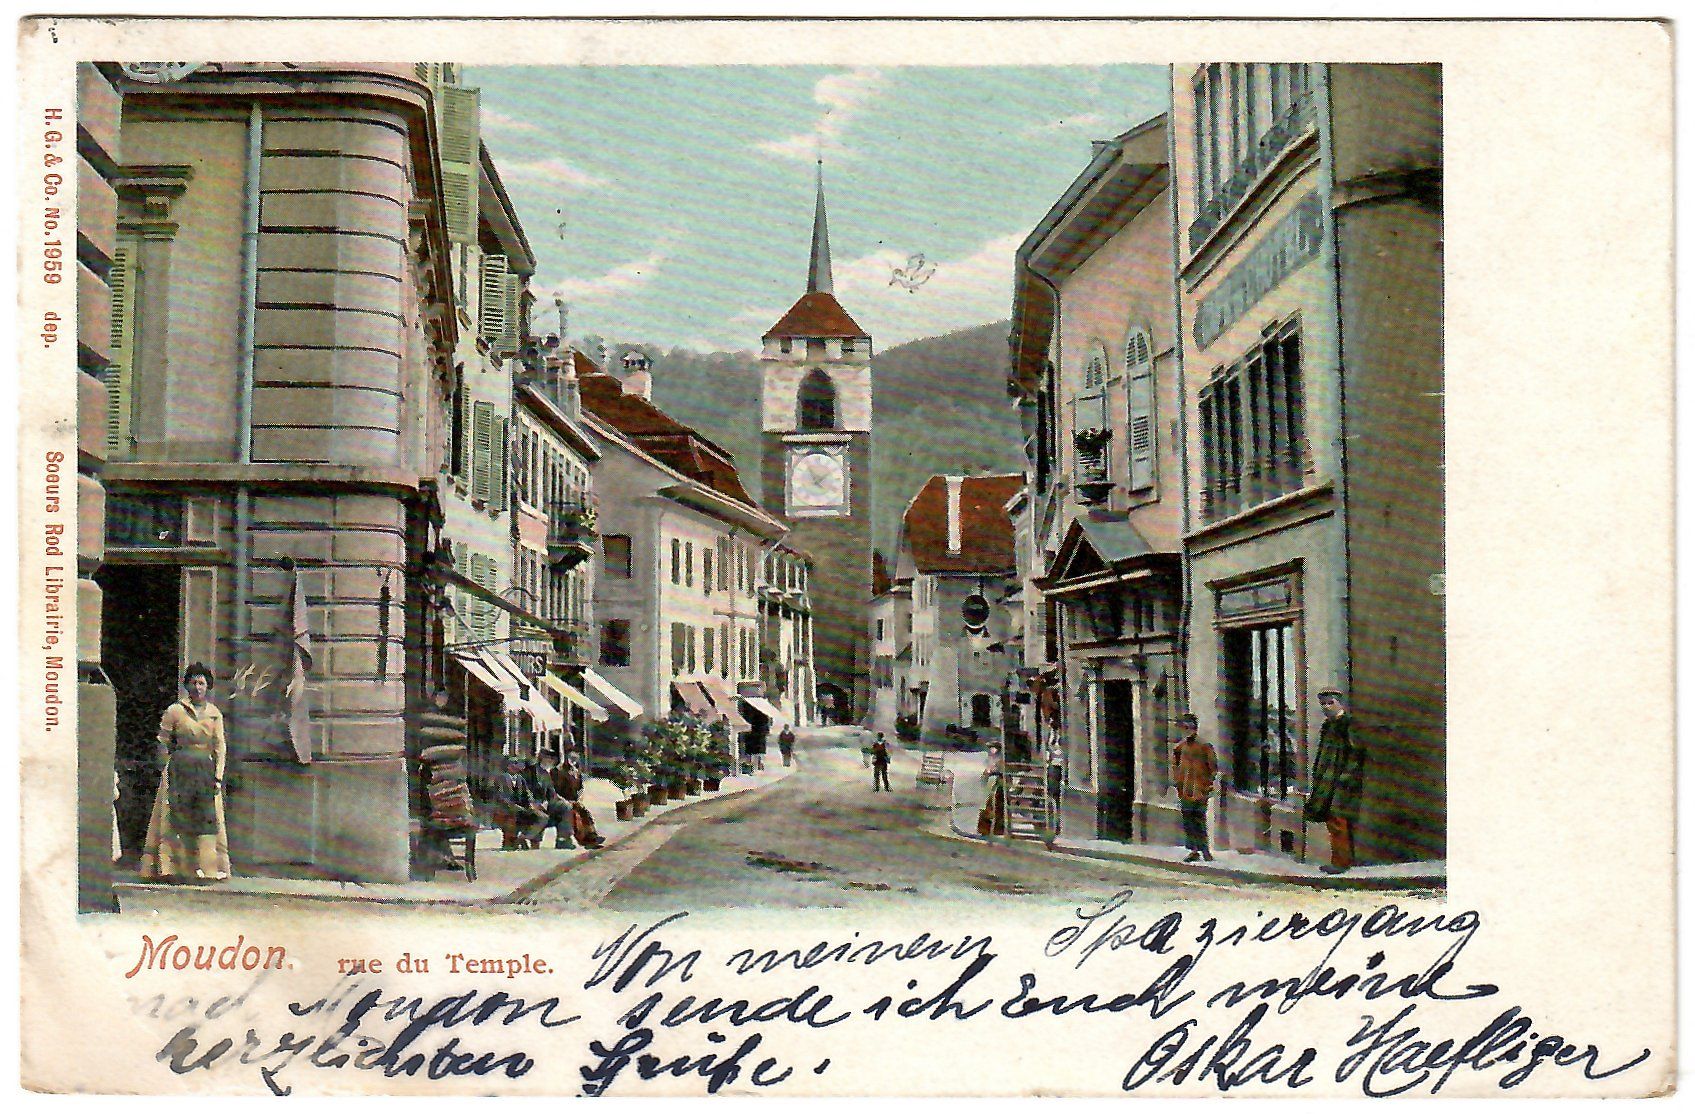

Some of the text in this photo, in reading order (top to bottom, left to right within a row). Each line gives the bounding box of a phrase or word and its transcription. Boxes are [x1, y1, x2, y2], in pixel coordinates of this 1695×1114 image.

[41, 108, 63, 349] H. G. & Co. No. 1959 dep.
[45, 523, 64, 556] Rod
[42, 566, 64, 651] Librairie,
[44, 656, 64, 732] Moudon.
[125, 934, 293, 978] Moudon.
[337, 953, 554, 978] rue du Temple.
[584, 911, 701, 992] Von
[617, 985, 851, 1028] sende
[864, 953, 997, 1020] ich
[1001, 954, 1195, 1019] Euch
[1121, 1003, 1318, 1091] Oskar
